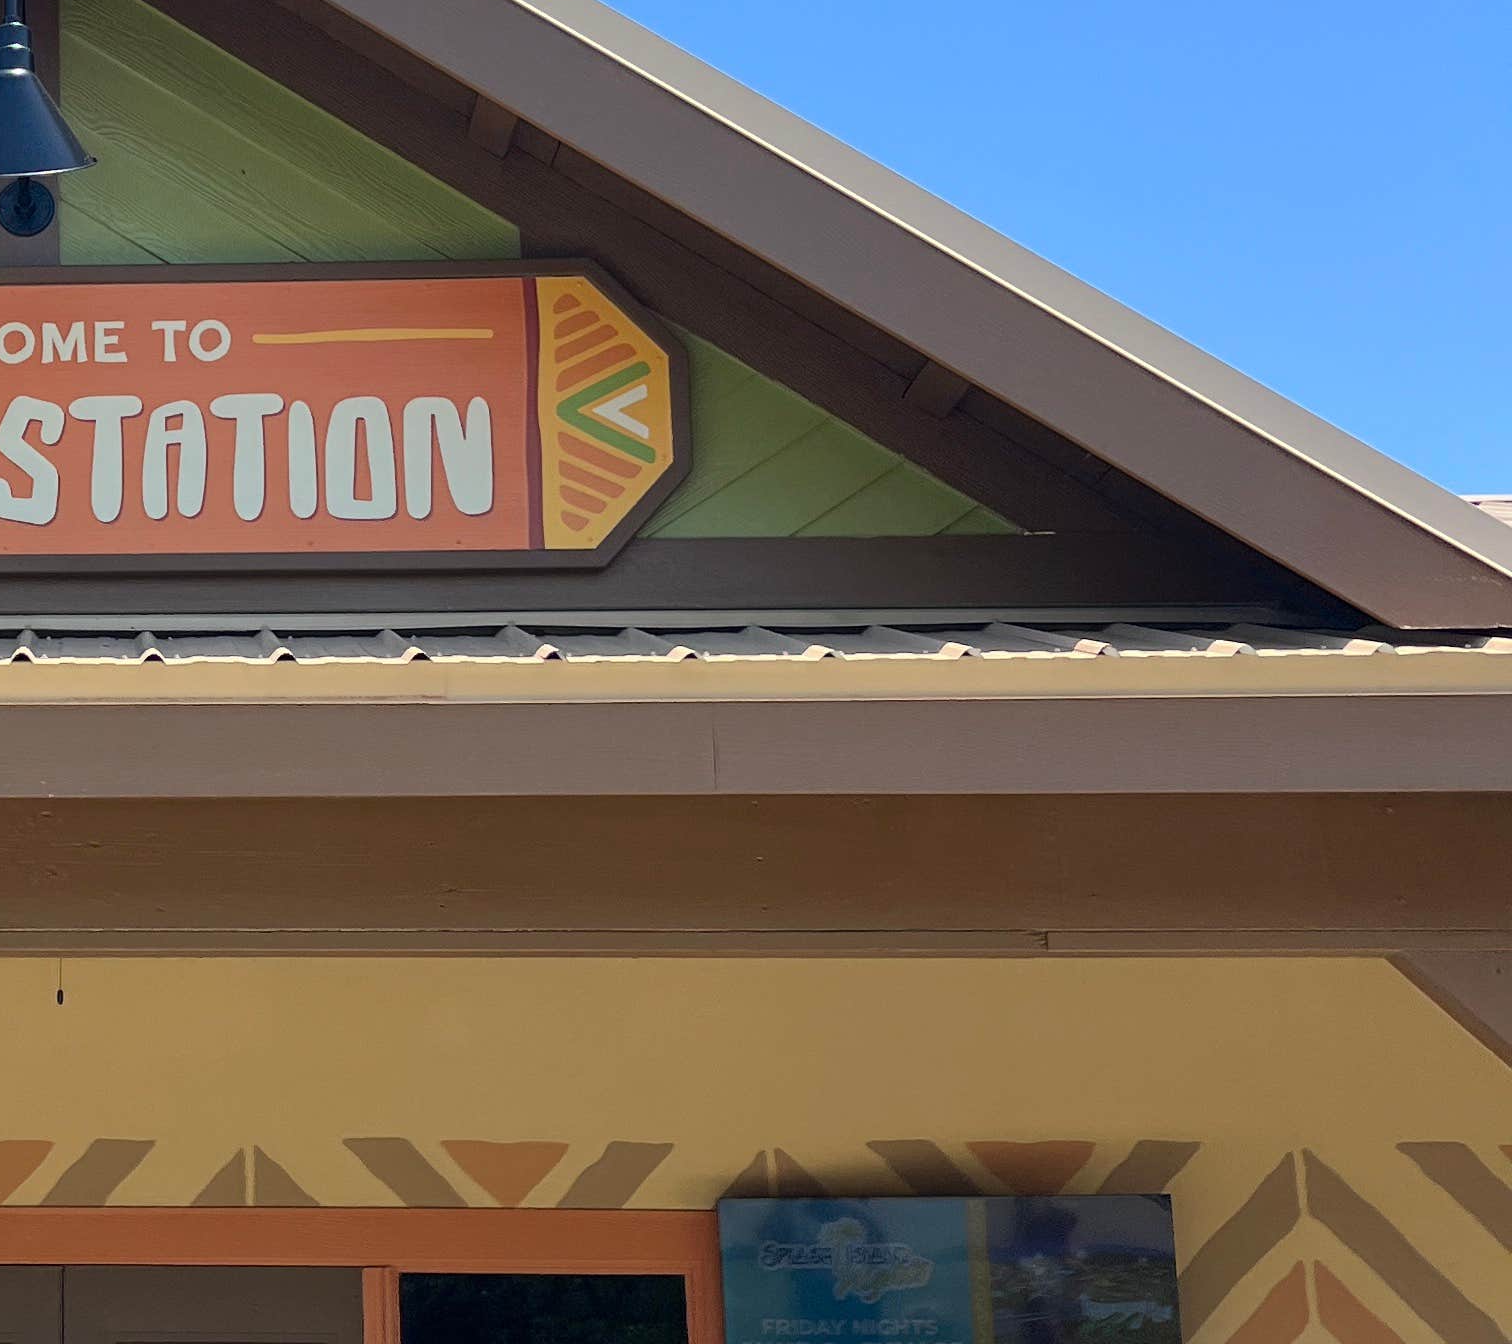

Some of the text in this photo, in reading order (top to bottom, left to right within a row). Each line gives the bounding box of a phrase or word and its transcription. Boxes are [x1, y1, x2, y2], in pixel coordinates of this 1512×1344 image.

[152, 319, 231, 362] TO
[761, 1318, 938, 1335] FRIDAY NIGHTS
